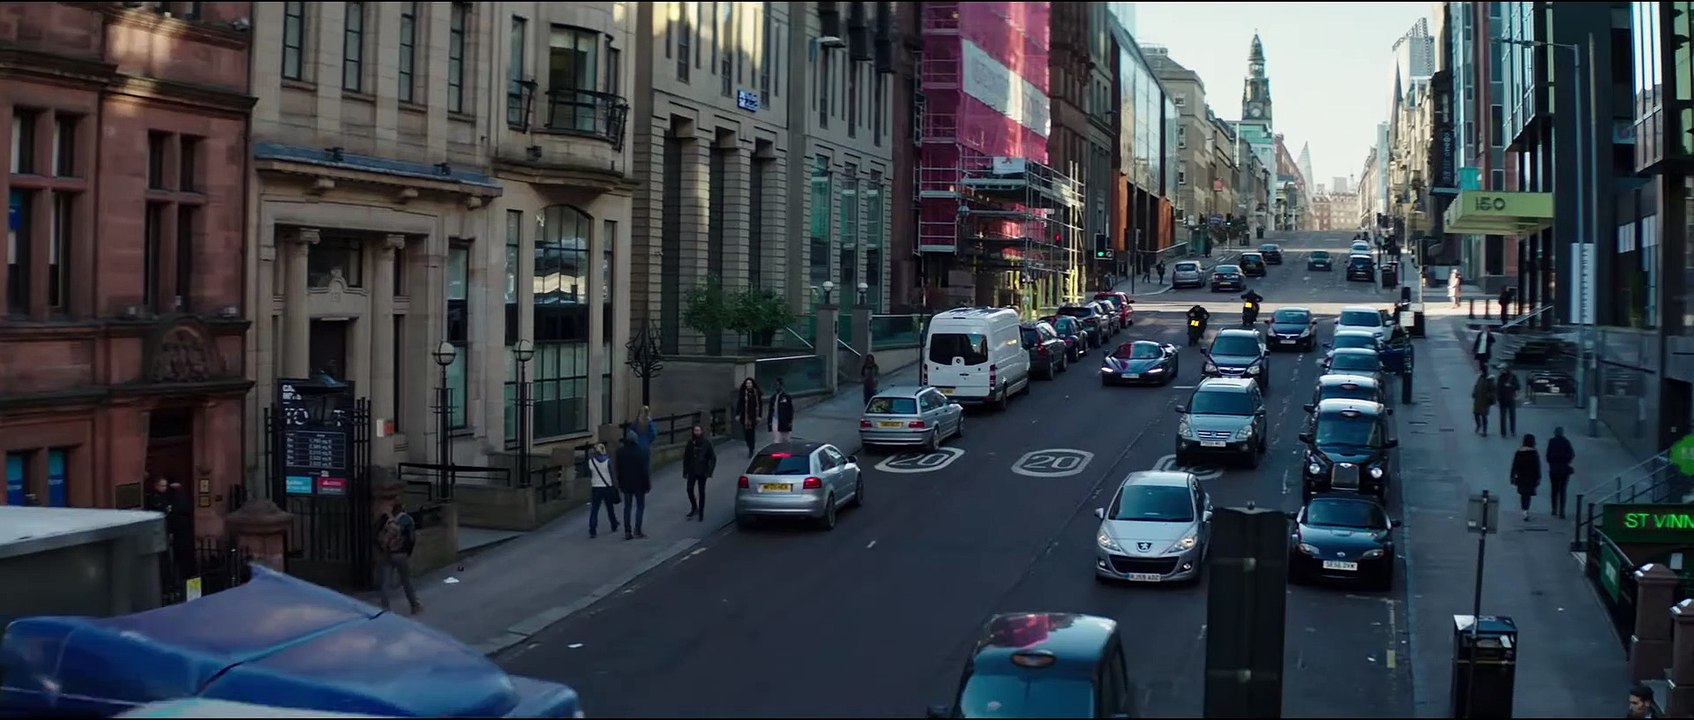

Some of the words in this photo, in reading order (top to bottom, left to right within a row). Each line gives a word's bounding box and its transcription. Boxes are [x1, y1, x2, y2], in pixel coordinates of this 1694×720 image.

[1475, 196, 1506, 211] 150
[1023, 455, 1082, 469] 20
[1624, 513, 1650, 528] ST
